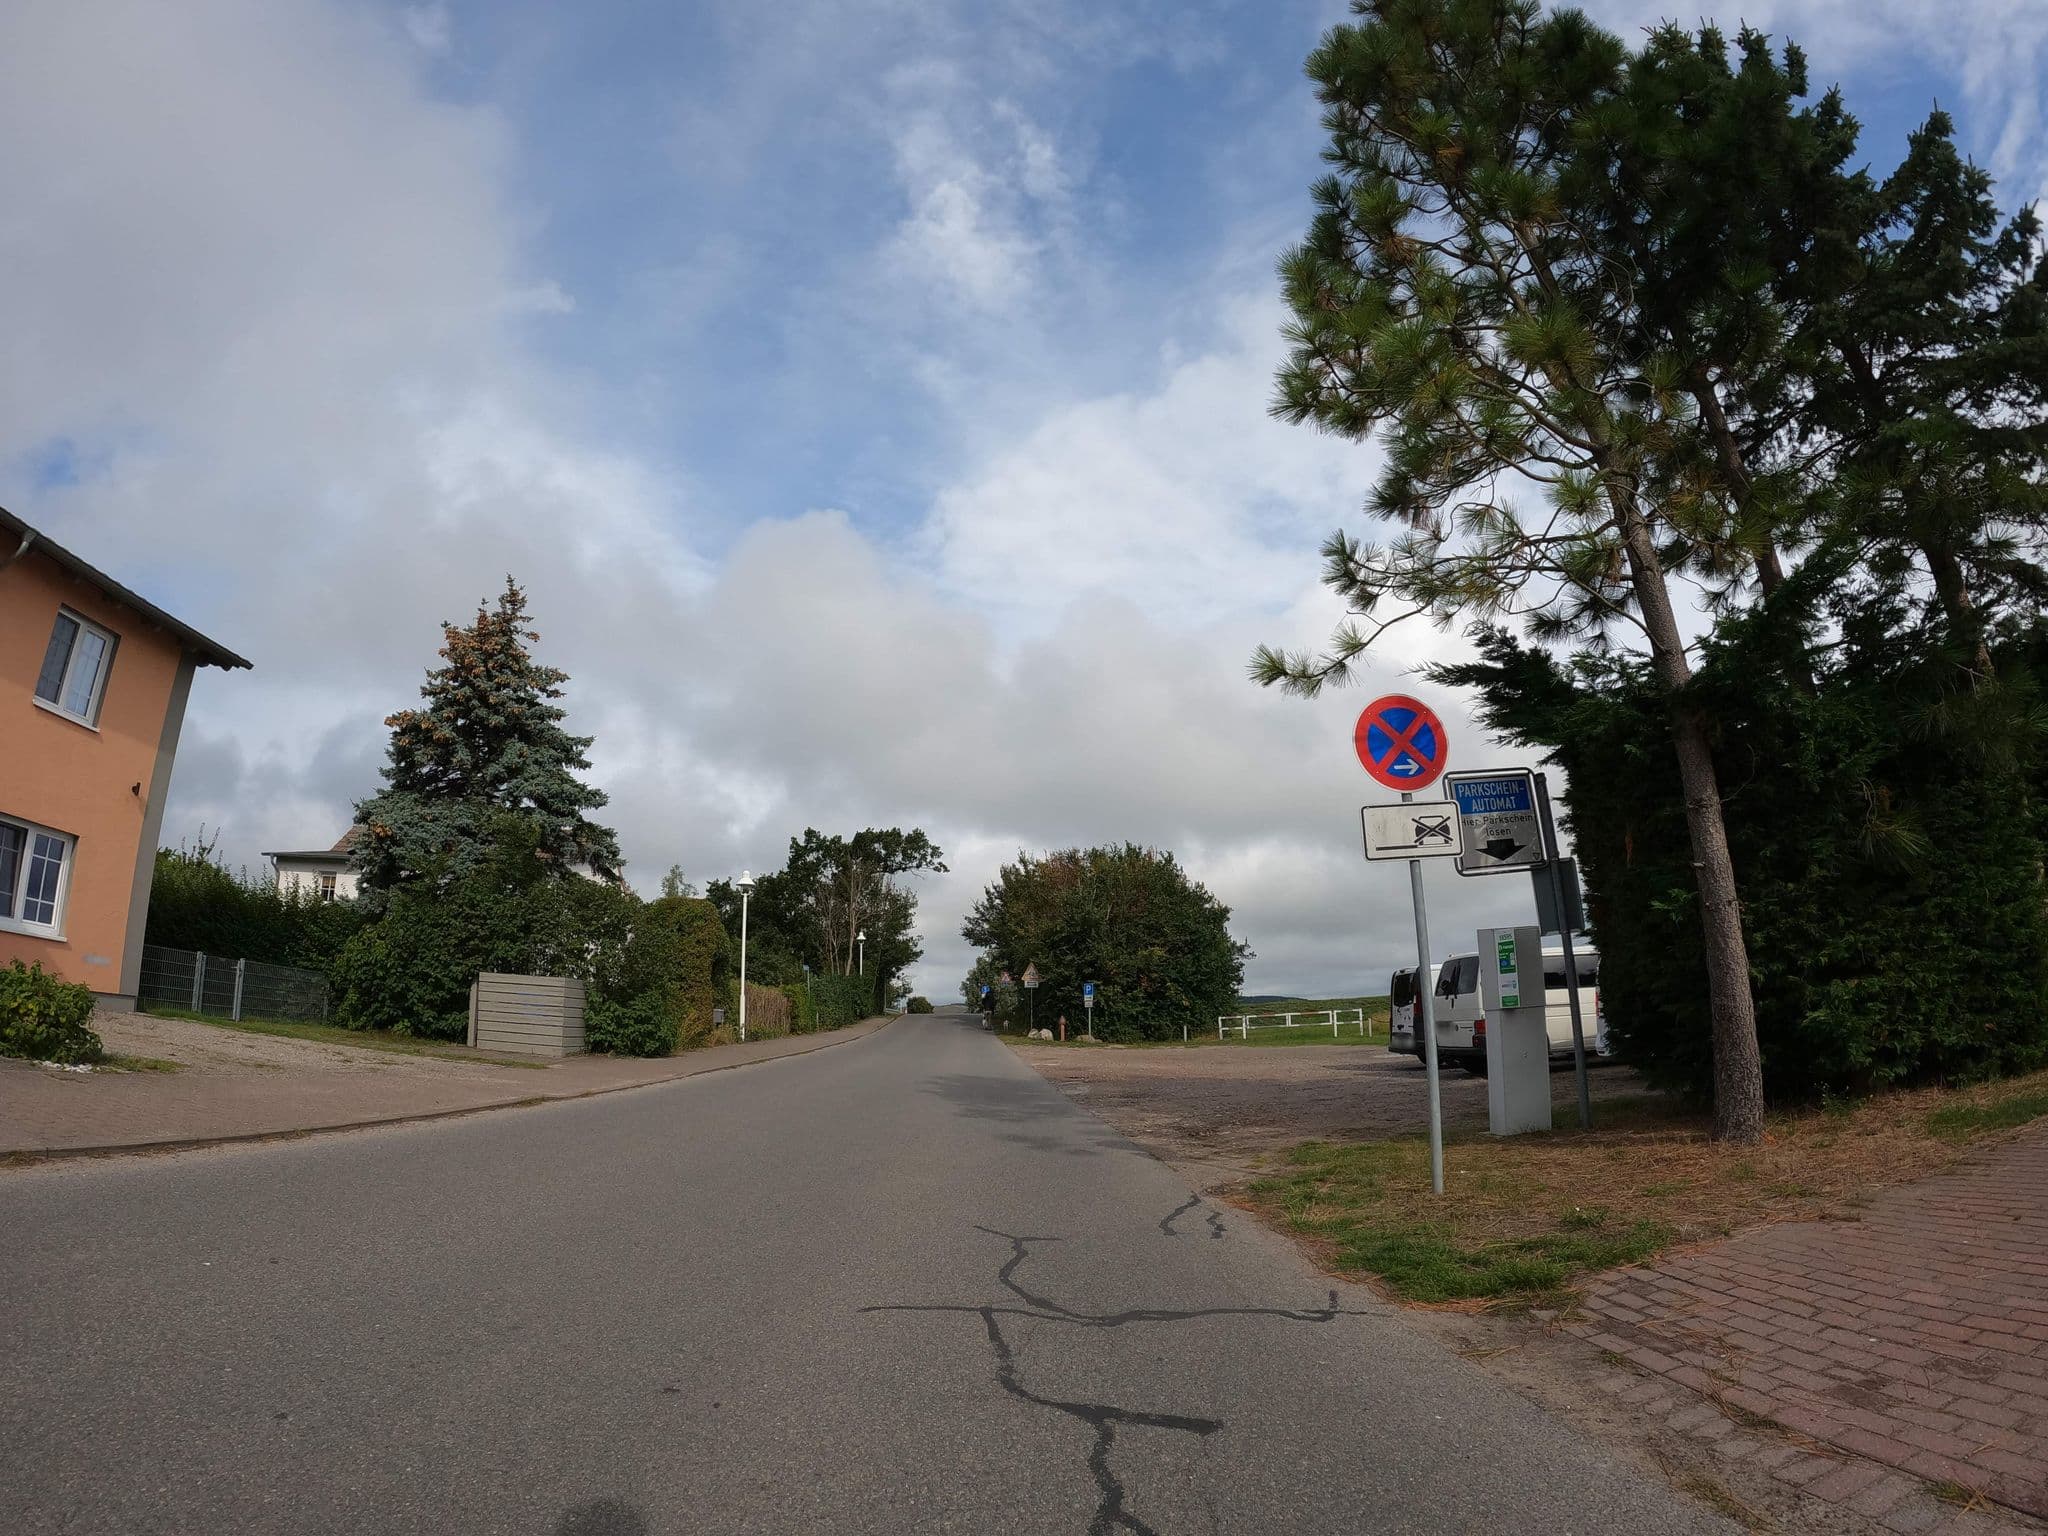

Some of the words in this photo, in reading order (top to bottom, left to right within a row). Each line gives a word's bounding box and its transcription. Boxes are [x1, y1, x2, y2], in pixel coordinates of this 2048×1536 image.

[1458, 781, 1524, 797] PARKSCHEIN-
[1472, 796, 1517, 812] AUTOMAT
[1483, 814, 1533, 825] Parkschein
